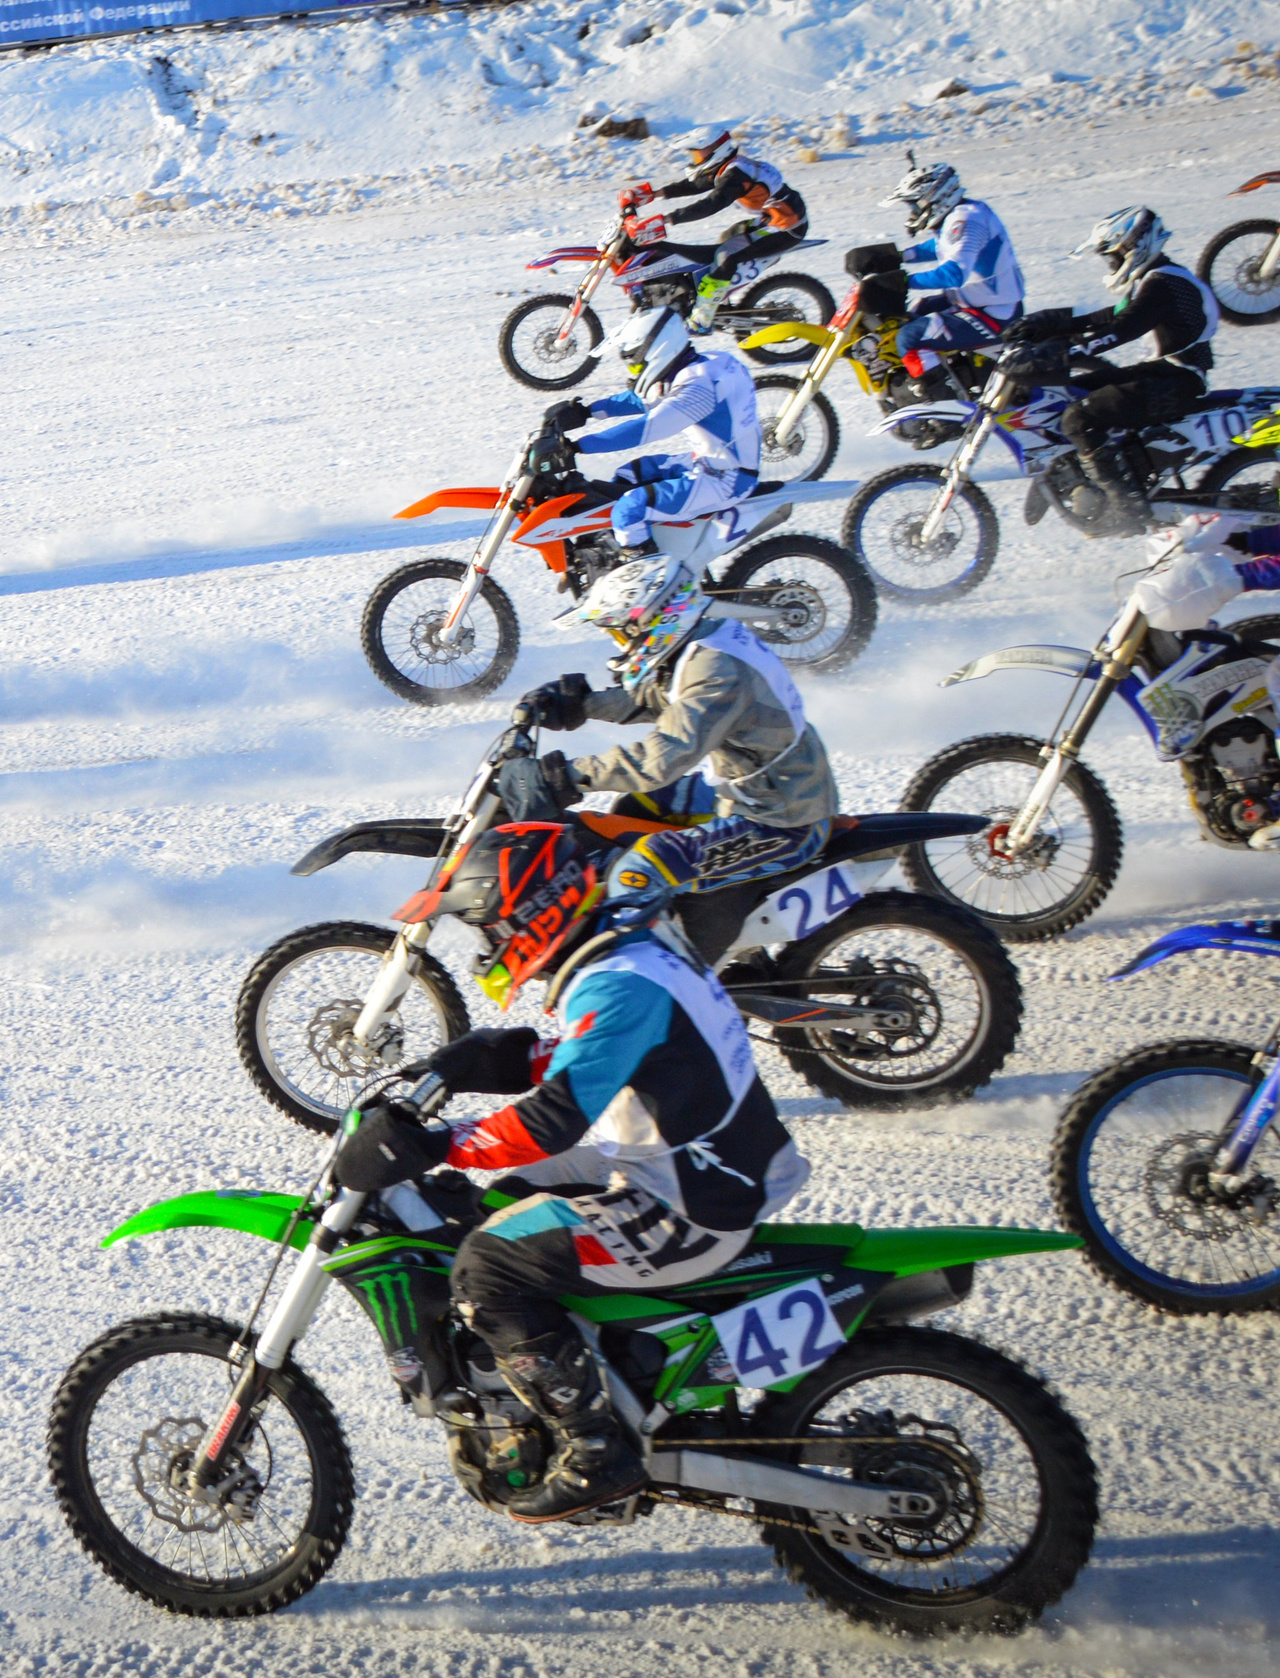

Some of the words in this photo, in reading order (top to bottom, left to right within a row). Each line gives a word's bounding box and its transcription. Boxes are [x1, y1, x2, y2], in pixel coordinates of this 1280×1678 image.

[89, 1, 191, 21] Федерации
[1195, 410, 1246, 447] 10
[721, 507, 747, 543] 2
[778, 866, 866, 940] 24
[737, 1289, 848, 1378] 42
